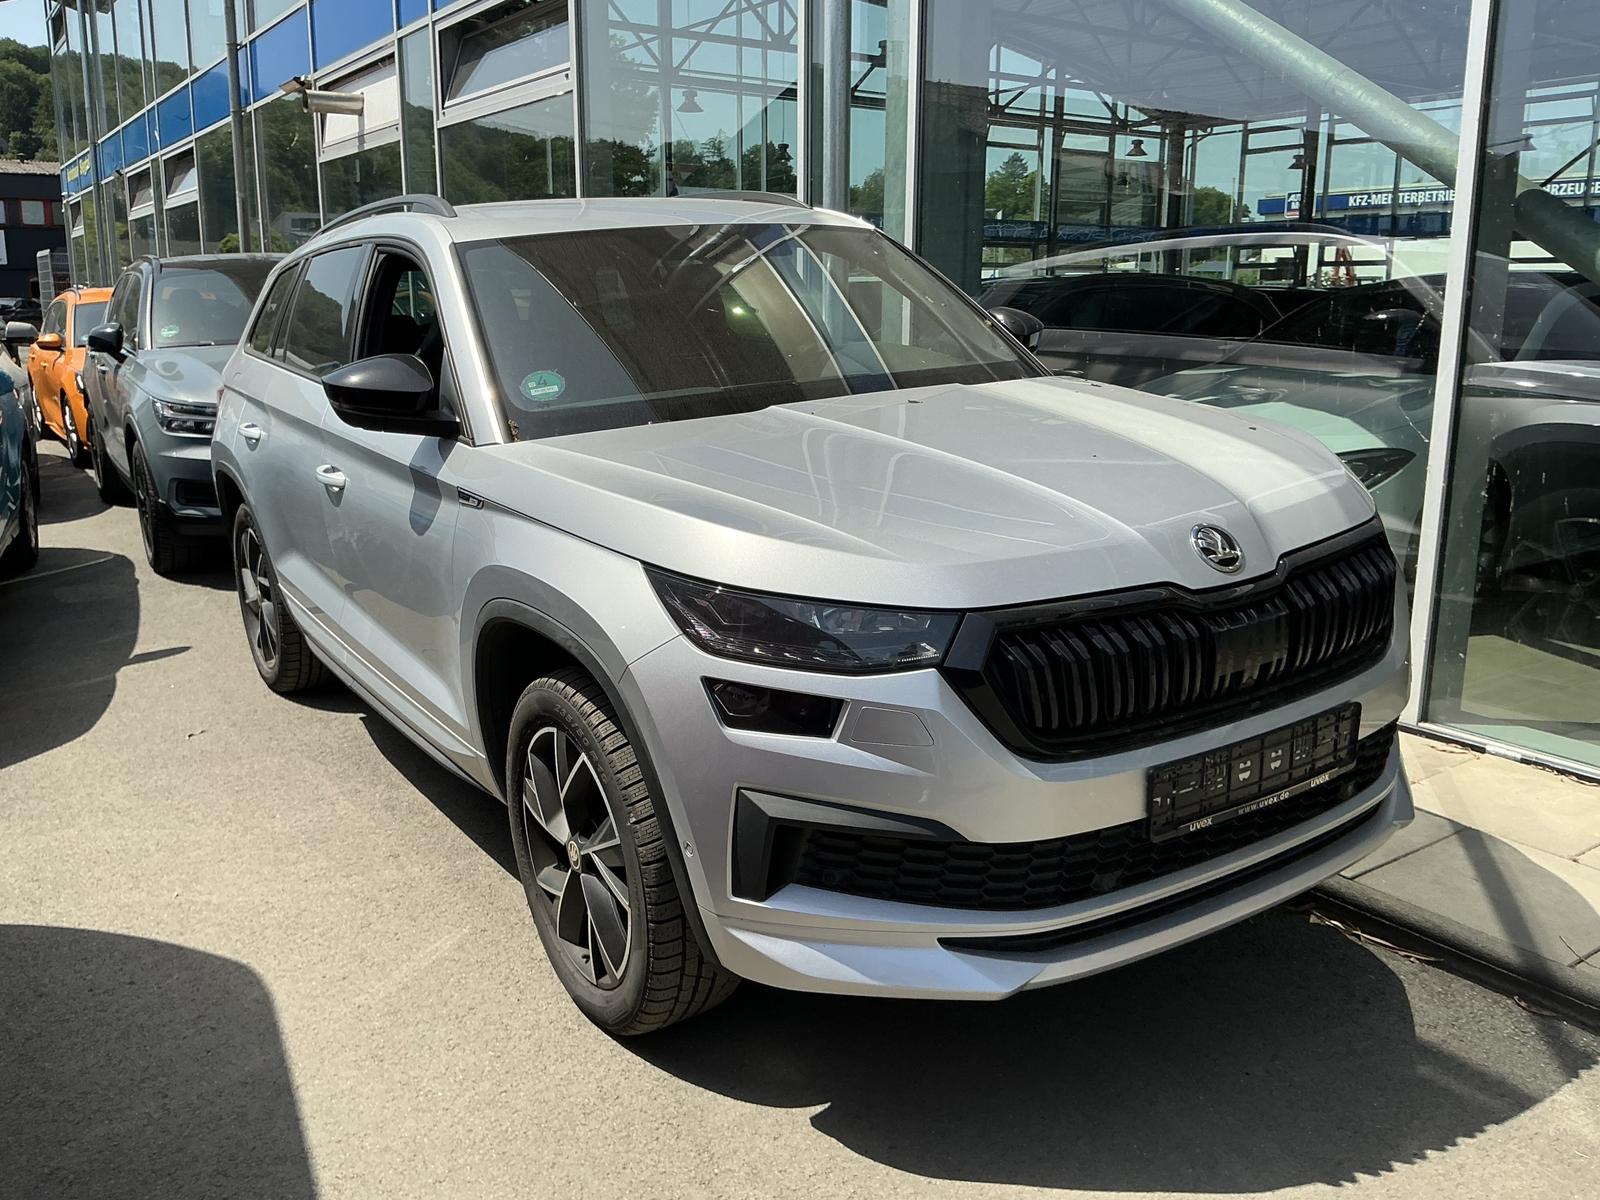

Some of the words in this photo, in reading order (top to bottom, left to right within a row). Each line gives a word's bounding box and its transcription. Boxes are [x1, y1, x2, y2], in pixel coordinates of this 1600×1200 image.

[1348, 189, 1456, 207] KFZ-MEITERBETRIE
[1309, 773, 1330, 788] uvex
[1238, 790, 1290, 815] www.uvex.de
[1189, 816, 1214, 832] uvex
